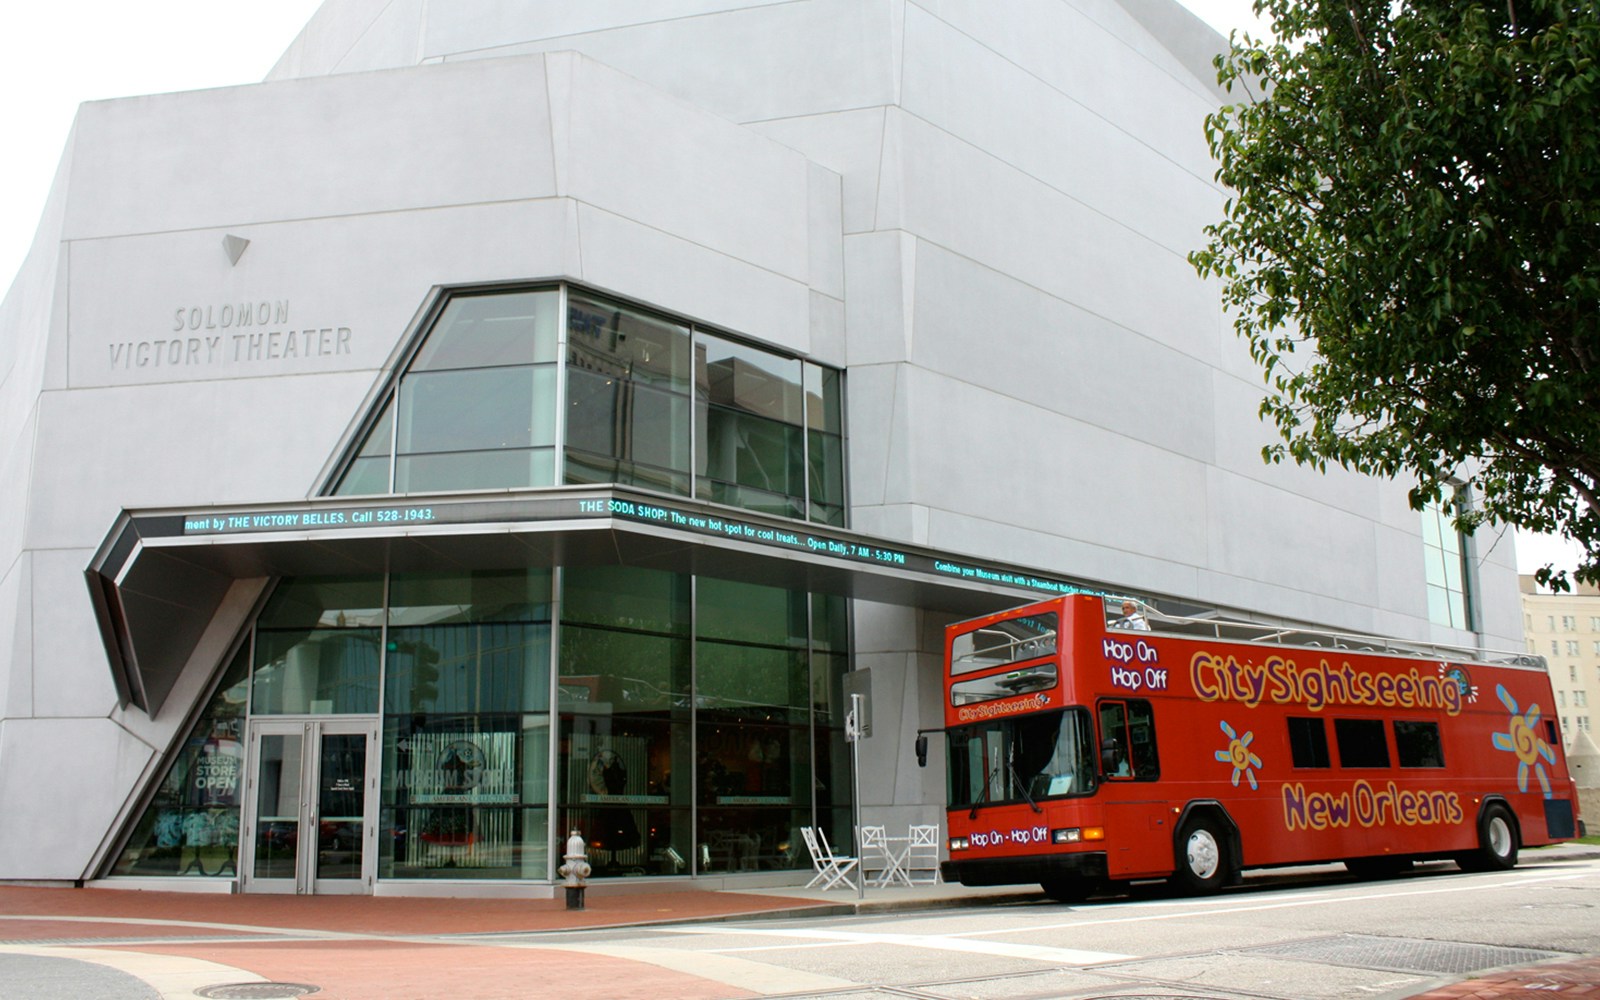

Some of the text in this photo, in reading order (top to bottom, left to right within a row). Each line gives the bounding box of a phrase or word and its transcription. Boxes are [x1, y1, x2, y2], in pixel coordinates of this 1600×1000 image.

[173, 299, 289, 332] SOLOMON
[109, 327, 352, 370] VICTORY THEATER
[213, 518, 225, 531] by
[228, 517, 250, 528] THE
[253, 514, 299, 527] VICTORY
[302, 513, 348, 525] BELLES.
[352, 511, 373, 523] Call
[377, 509, 435, 522] 528-1943.
[579, 501, 604, 513] THE
[607, 500, 635, 515] SODA
[638, 505, 668, 520] SHOP!
[670, 511, 687, 525] The
[688, 518, 706, 528] new
[708, 519, 722, 531] hot
[724, 523, 742, 535] spot
[744, 525, 755, 537] for
[757, 530, 774, 541] cool
[807, 537, 826, 550] Open
[828, 541, 850, 556] Daily,
[850, 545, 857, 555] 7
[858, 547, 870, 558] AM
[876, 550, 892, 561] 5:30
[894, 553, 904, 564] PM
[935, 561, 960, 574] Combine
[962, 568, 974, 576] your
[976, 569, 1000, 580] Museum
[1014, 577, 1025, 585] with
[1103, 639, 1158, 663] Hop On
[1111, 667, 1168, 690] Hop Off
[1190, 650, 1462, 716] CitySightseeing
[959, 698, 1043, 720] CitySightseeing
[197, 756, 236, 765] MUSEUM
[197, 765, 236, 776] STORE
[195, 777, 236, 790] OPEN
[1281, 779, 1463, 831] New Orleans
[970, 833, 989, 847] Hop
[990, 831, 1004, 845] On
[1011, 829, 1031, 844] Hop
[1032, 827, 1048, 842] Off
